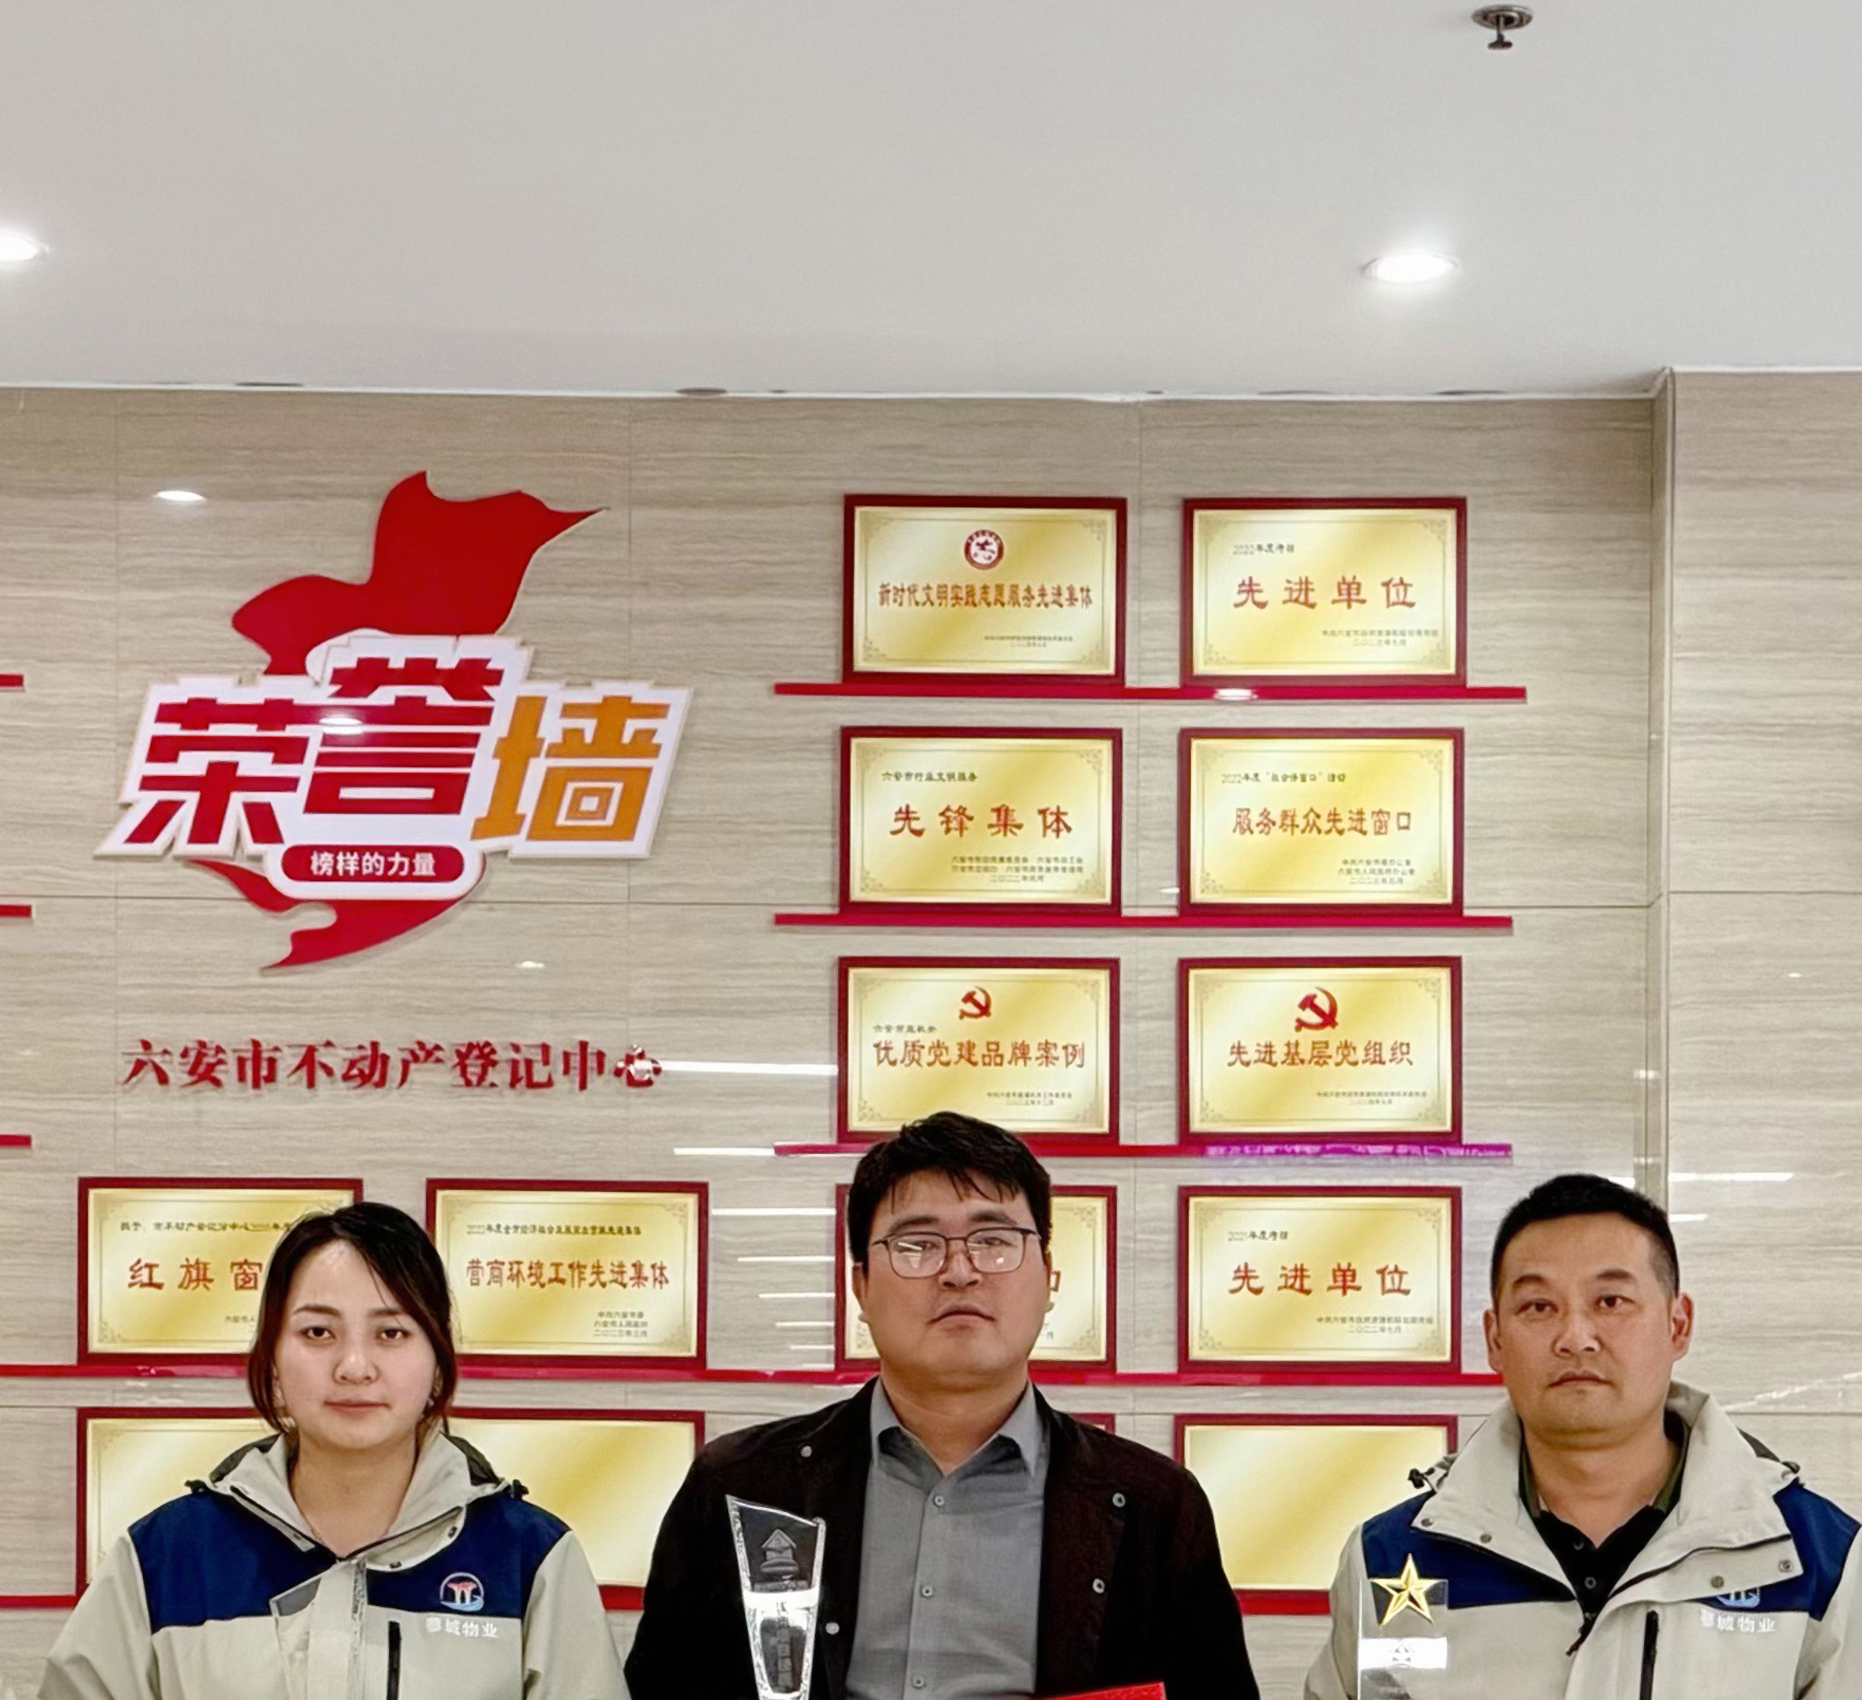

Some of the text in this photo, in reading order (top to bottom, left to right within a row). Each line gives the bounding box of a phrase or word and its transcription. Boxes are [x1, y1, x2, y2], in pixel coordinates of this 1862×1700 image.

[1233, 575, 1416, 609] 先进单位
[124, 657, 670, 846] 荣誉墙
[890, 804, 1072, 839] 先锋集体
[1233, 807, 1412, 836] 服务群众先进窗口
[310, 851, 436, 879] 榜样的力量
[122, 1038, 662, 1091] 六安市不动产登记中心
[873, 1039, 1085, 1069] 优质党建品牌案例
[1228, 1040, 1414, 1068] 先进基层党组织
[467, 1259, 670, 1290] 营商环境工作先进集体
[1229, 1262, 1412, 1297] 先进单位
